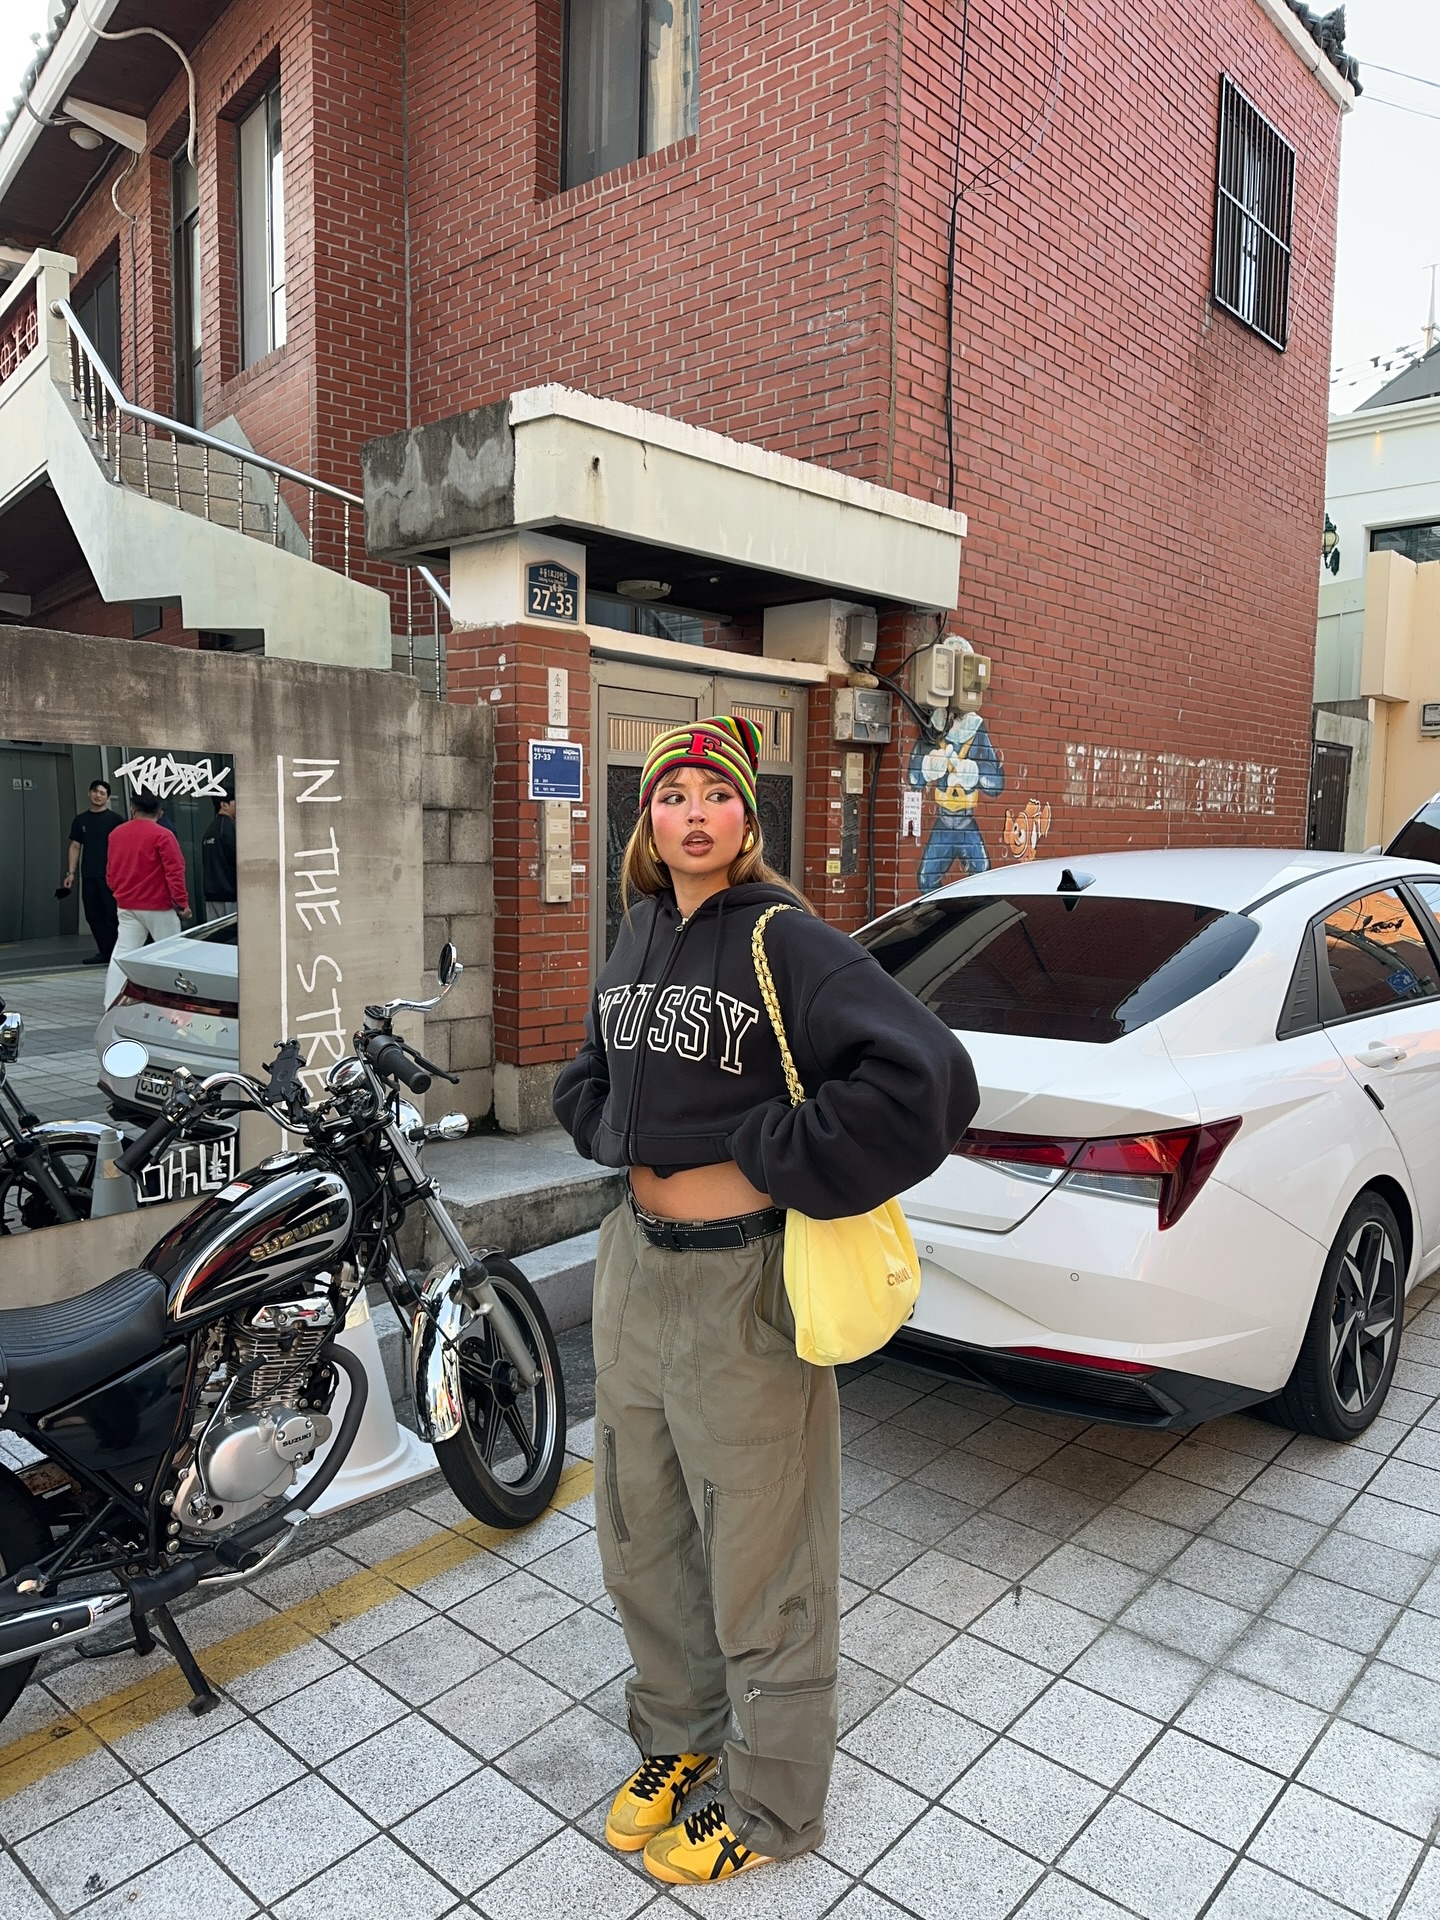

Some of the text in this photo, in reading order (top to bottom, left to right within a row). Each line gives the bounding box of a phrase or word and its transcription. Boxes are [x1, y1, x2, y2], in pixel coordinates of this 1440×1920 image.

[532, 587, 573, 616] 27-33
[686, 733, 722, 756] F
[293, 759, 343, 803] IN
[294, 827, 342, 932] THE
[248, 1212, 332, 1263] SUZUKI
[282, 1432, 312, 1447] SUZUKI
